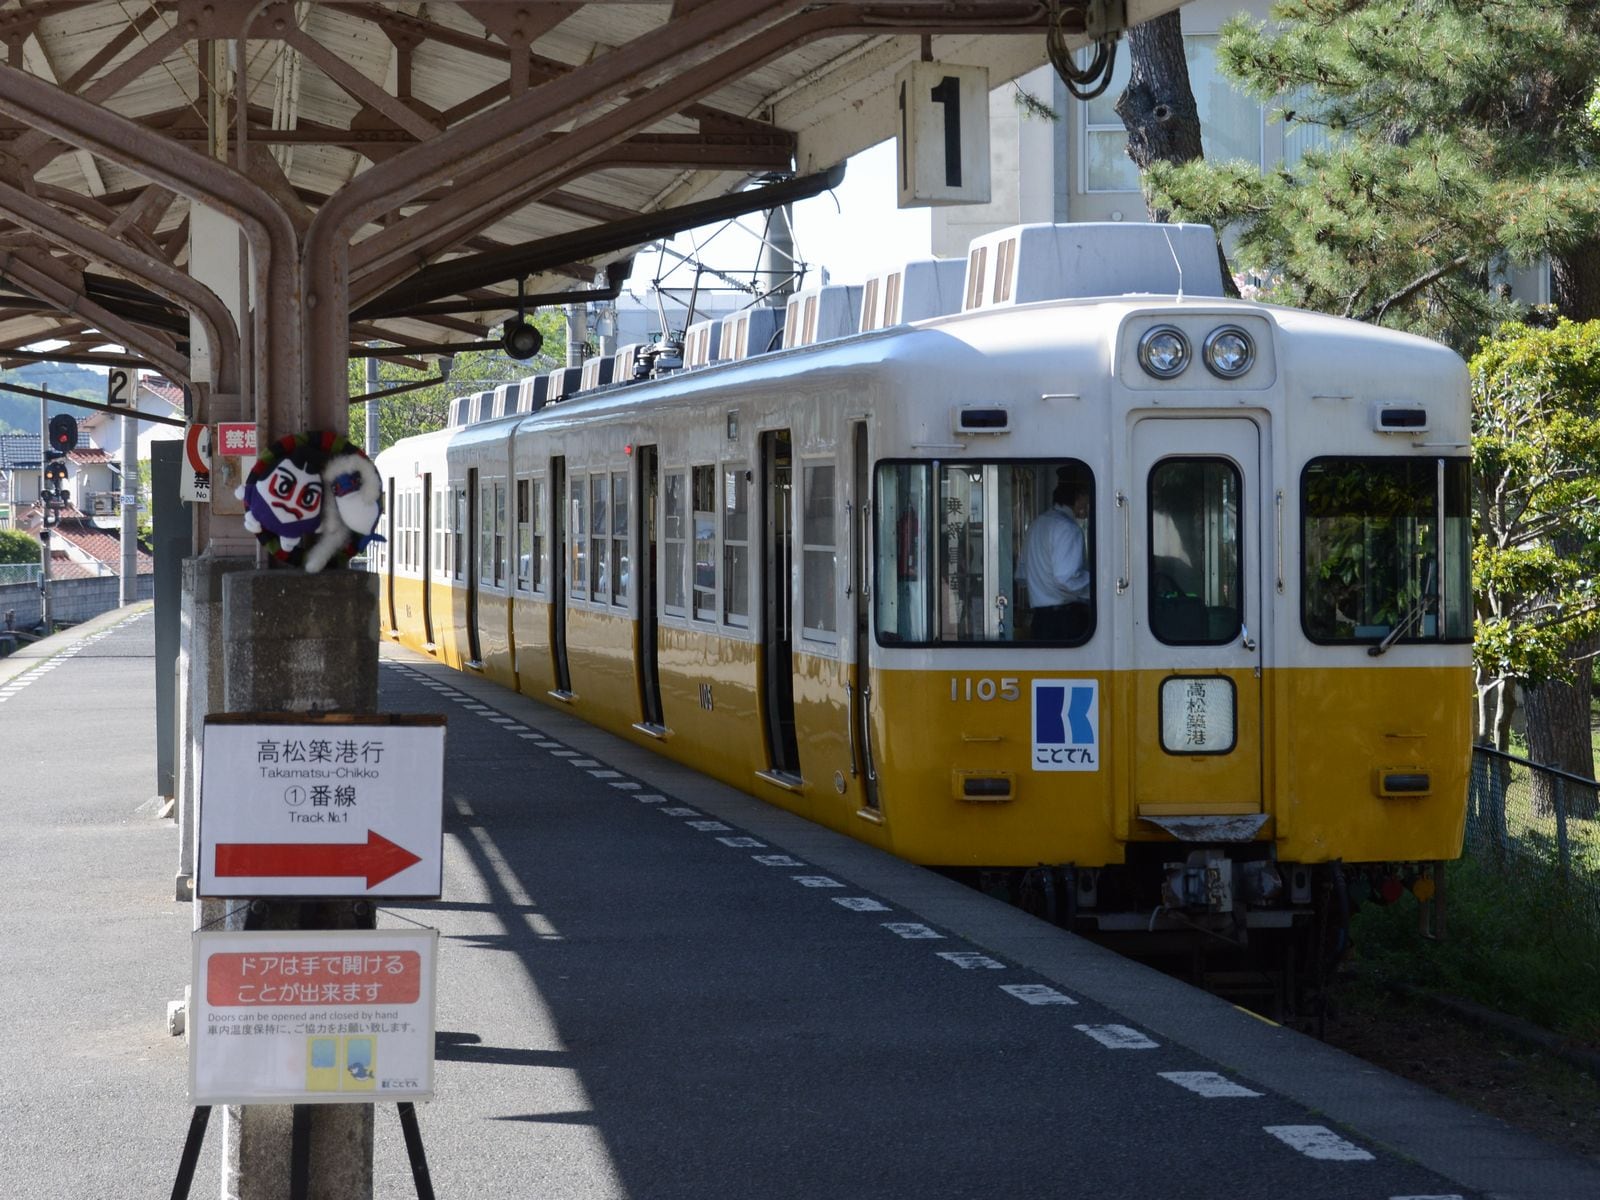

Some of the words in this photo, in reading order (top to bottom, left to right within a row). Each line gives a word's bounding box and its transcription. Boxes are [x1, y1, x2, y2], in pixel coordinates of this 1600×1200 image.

[931, 76, 962, 187] 1
[111, 371, 128, 404] 2
[951, 678, 1020, 701] 1105
[1186, 682, 1206, 745] 高松築港
[257, 739, 385, 764] 高松築港行
[1036, 748, 1095, 764] ことでん
[260, 767, 379, 779] Takamatsu-Chikko
[288, 811, 325, 823] Track
[241, 956, 404, 976] ドアは手で開ける
[238, 983, 384, 1003] ことが出来ます
[208, 1013, 236, 1022] Doors
[257, 1012, 269, 1021] be
[271, 1012, 307, 1022] opened
[309, 1012, 327, 1020] and
[329, 1011, 359, 1020] closed
[361, 1011, 373, 1021] by
[375, 1010, 399, 1019] hand
